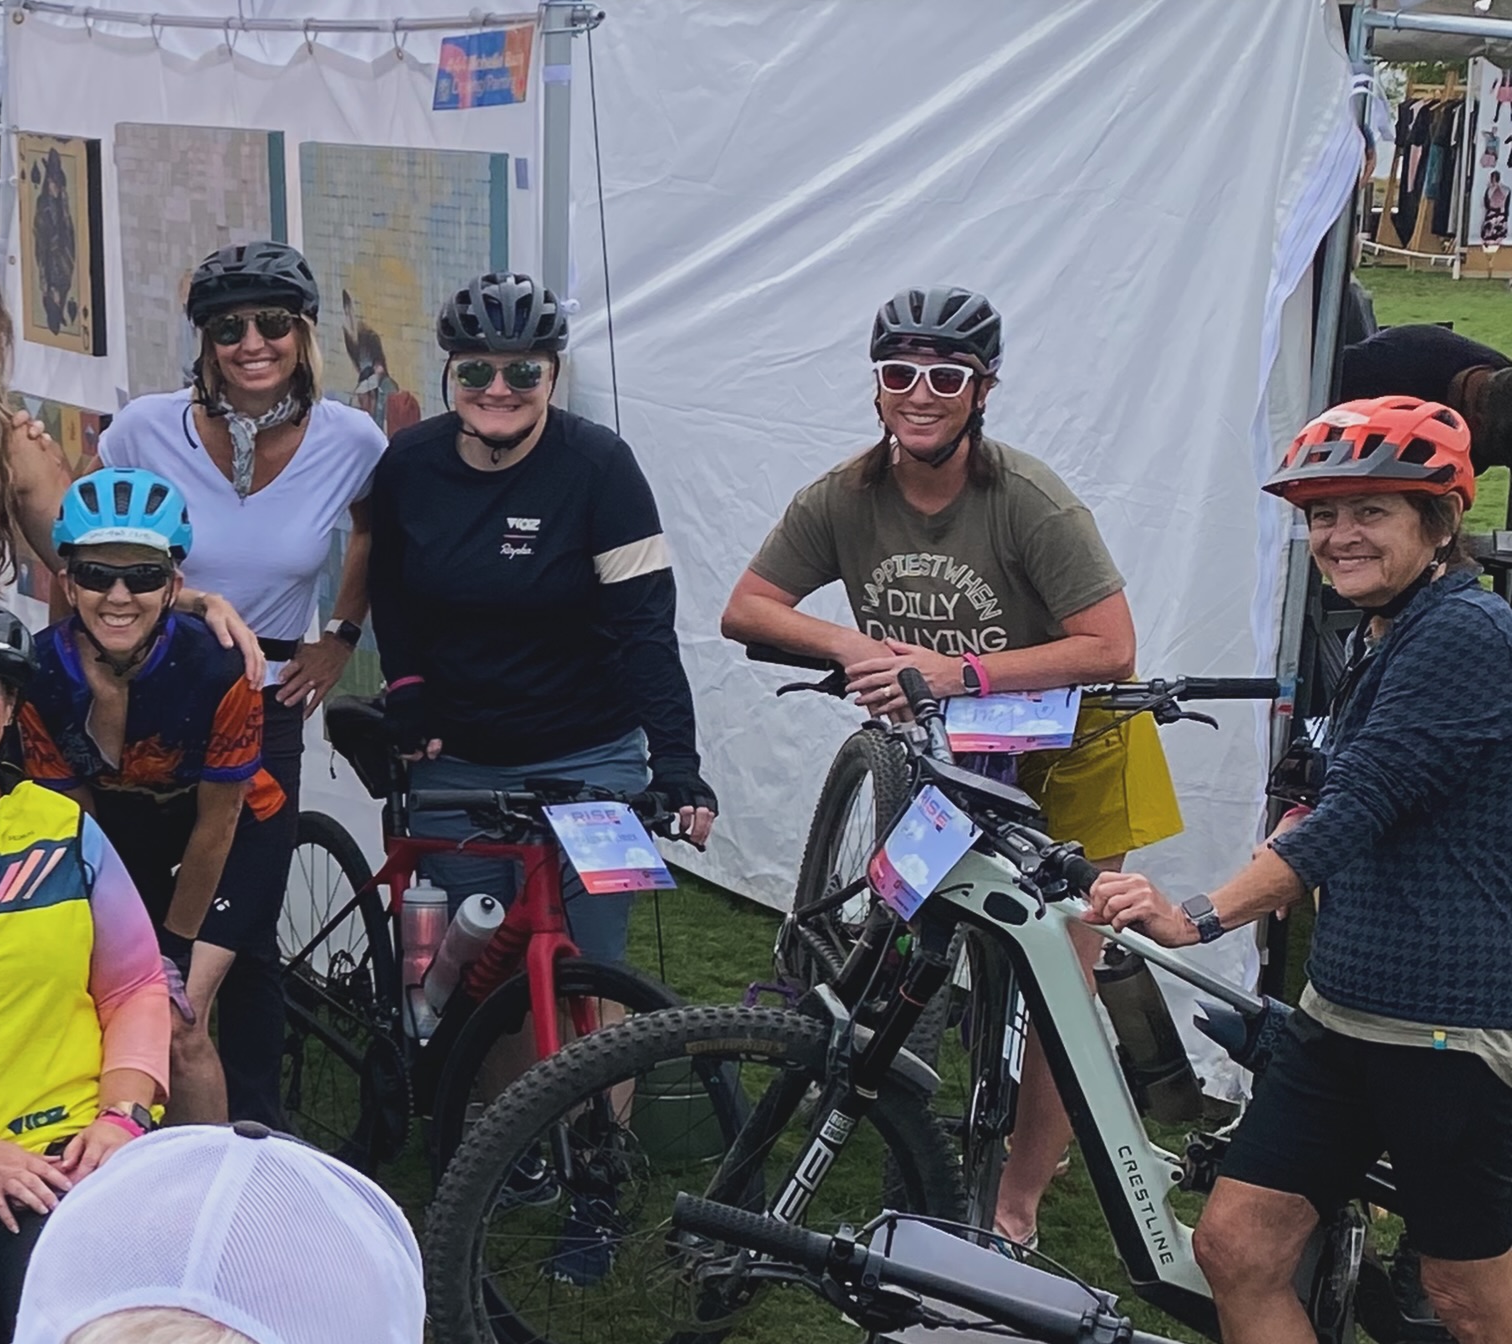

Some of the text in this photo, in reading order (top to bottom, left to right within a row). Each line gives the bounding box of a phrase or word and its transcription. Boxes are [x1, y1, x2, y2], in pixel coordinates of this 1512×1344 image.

[861, 553, 1003, 621] HAPPIEST WHEN
[887, 589, 961, 621] DILLY
[1117, 1145, 1174, 1265] CRESTLINE
